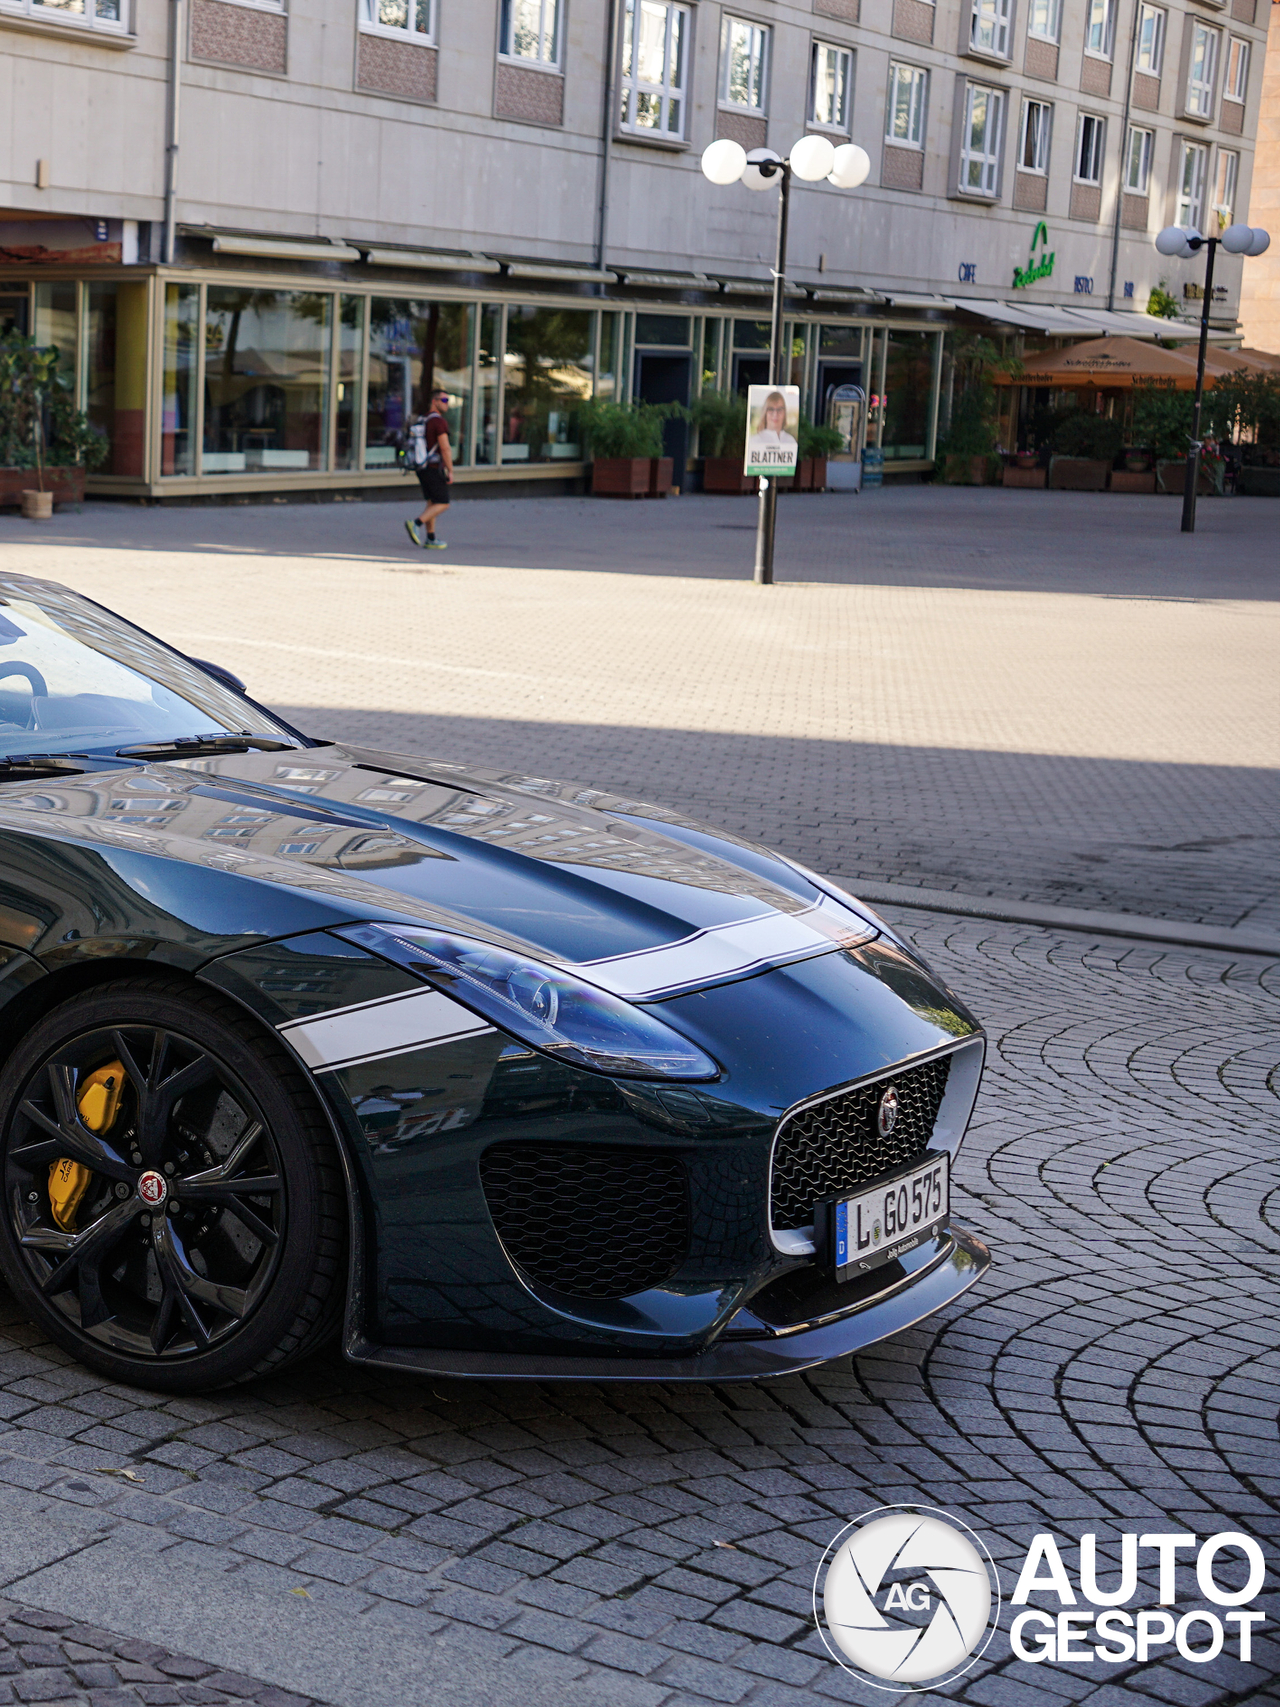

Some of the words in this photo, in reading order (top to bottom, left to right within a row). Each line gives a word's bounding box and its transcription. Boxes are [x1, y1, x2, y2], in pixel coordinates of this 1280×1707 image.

[1074, 275, 1094, 295] BISTRO
[751, 450, 794, 464] BLATTNER
[857, 1203, 870, 1250] L
[884, 1184, 908, 1237] GO
[912, 1166, 942, 1224] 575
[838, 1240, 845, 1255] D
